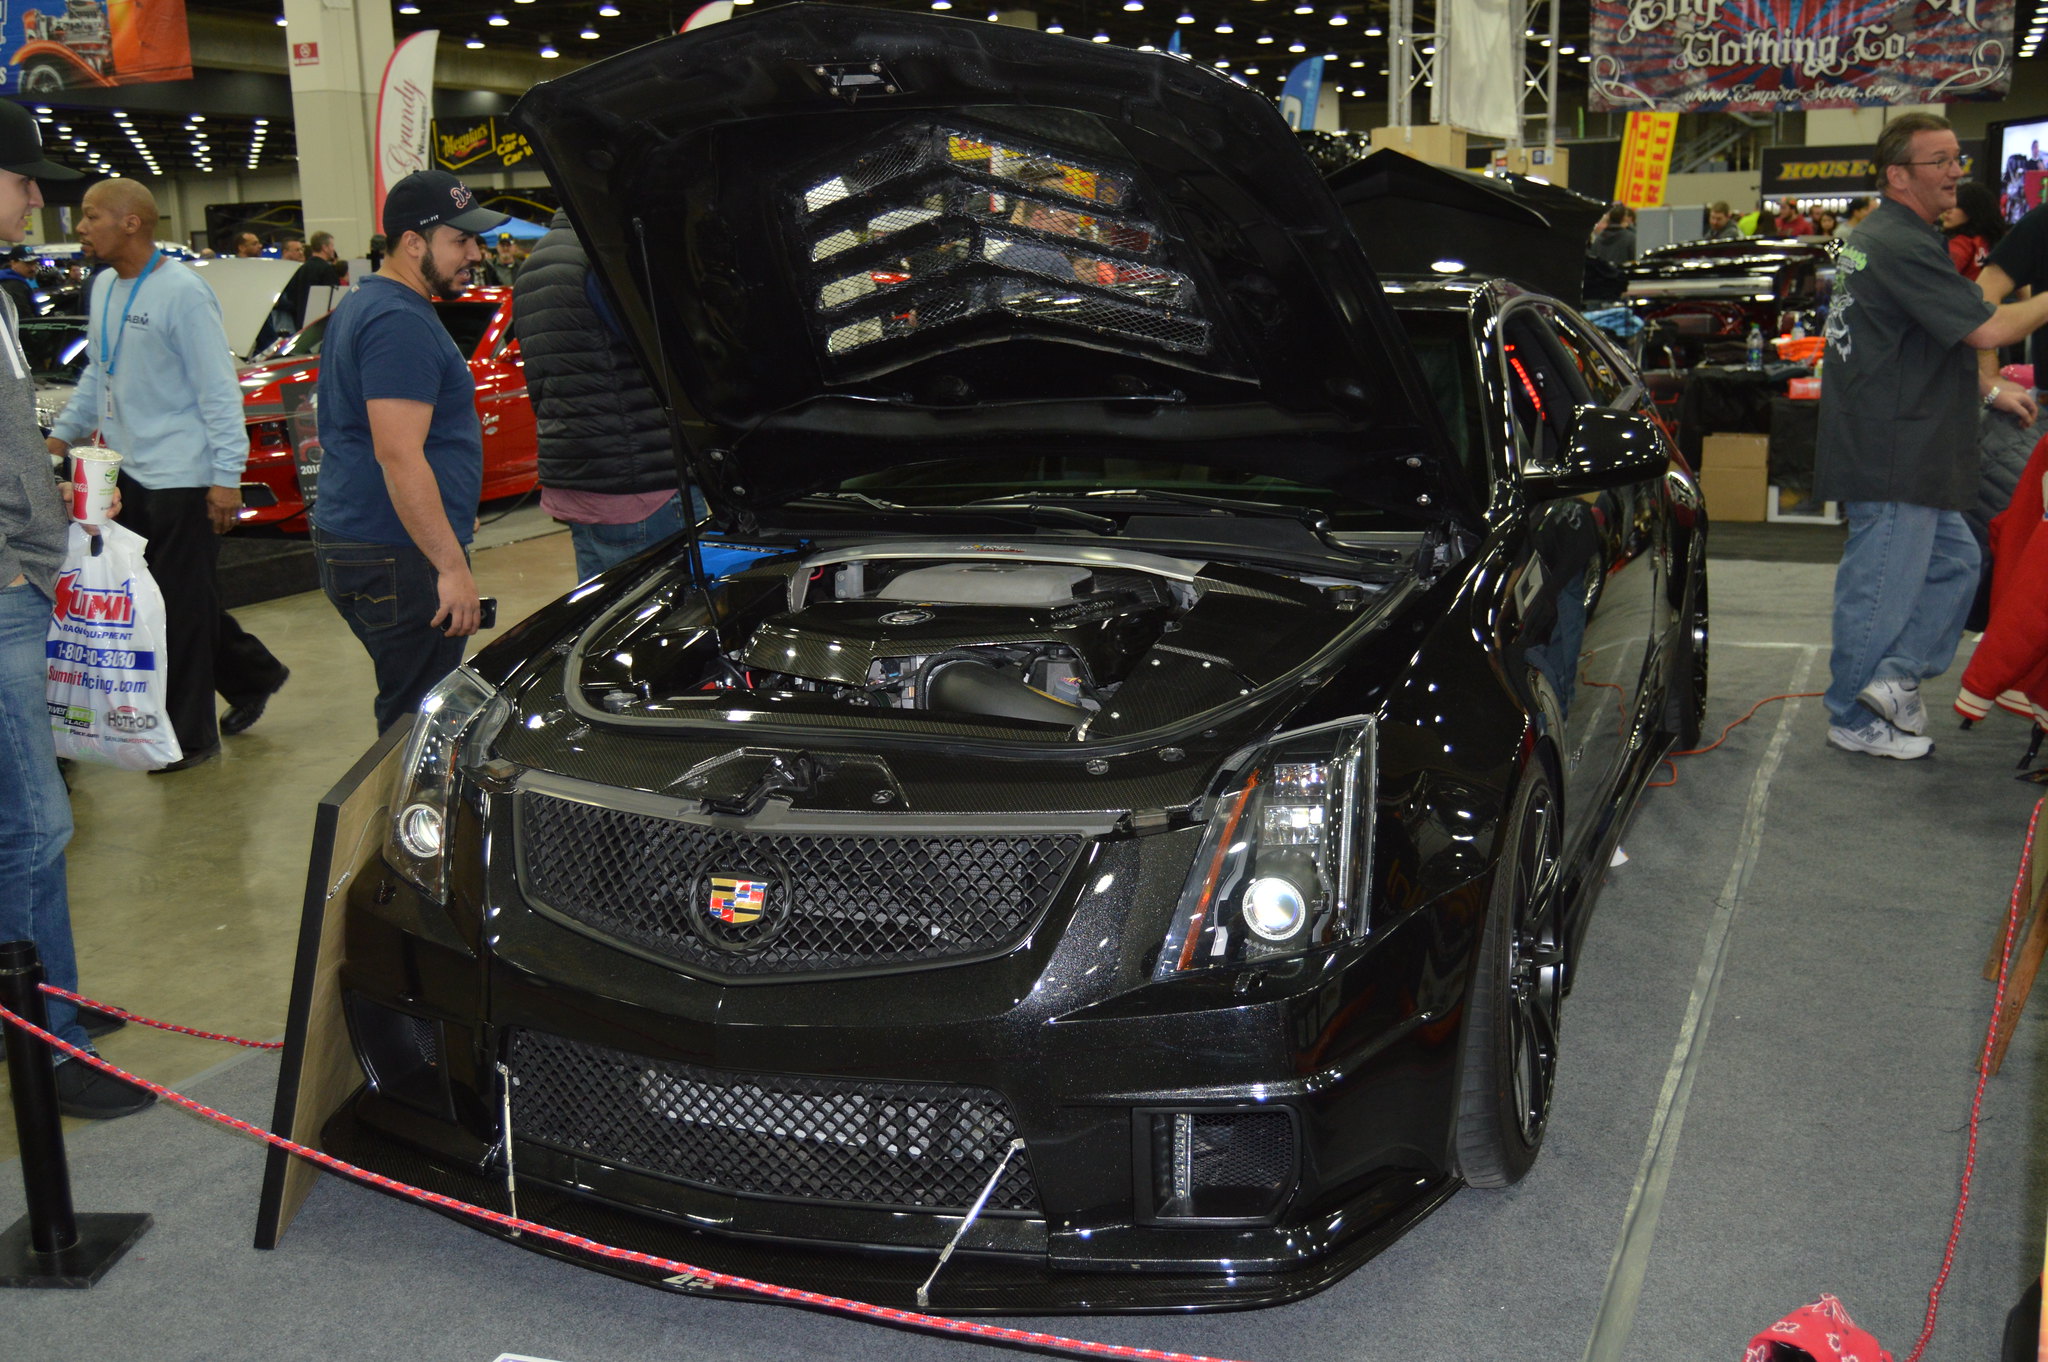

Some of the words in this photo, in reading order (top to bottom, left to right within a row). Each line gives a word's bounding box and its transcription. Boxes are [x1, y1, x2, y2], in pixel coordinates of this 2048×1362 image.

[1675, 27, 1847, 77] Clothing
[1844, 24, 1916, 64] Co.
[387, 80, 427, 174] Grundy
[1777, 160, 1870, 181] HOUSE
[53, 573, 133, 622] SUMIT
[49, 665, 147, 694] SumitRcing.com
